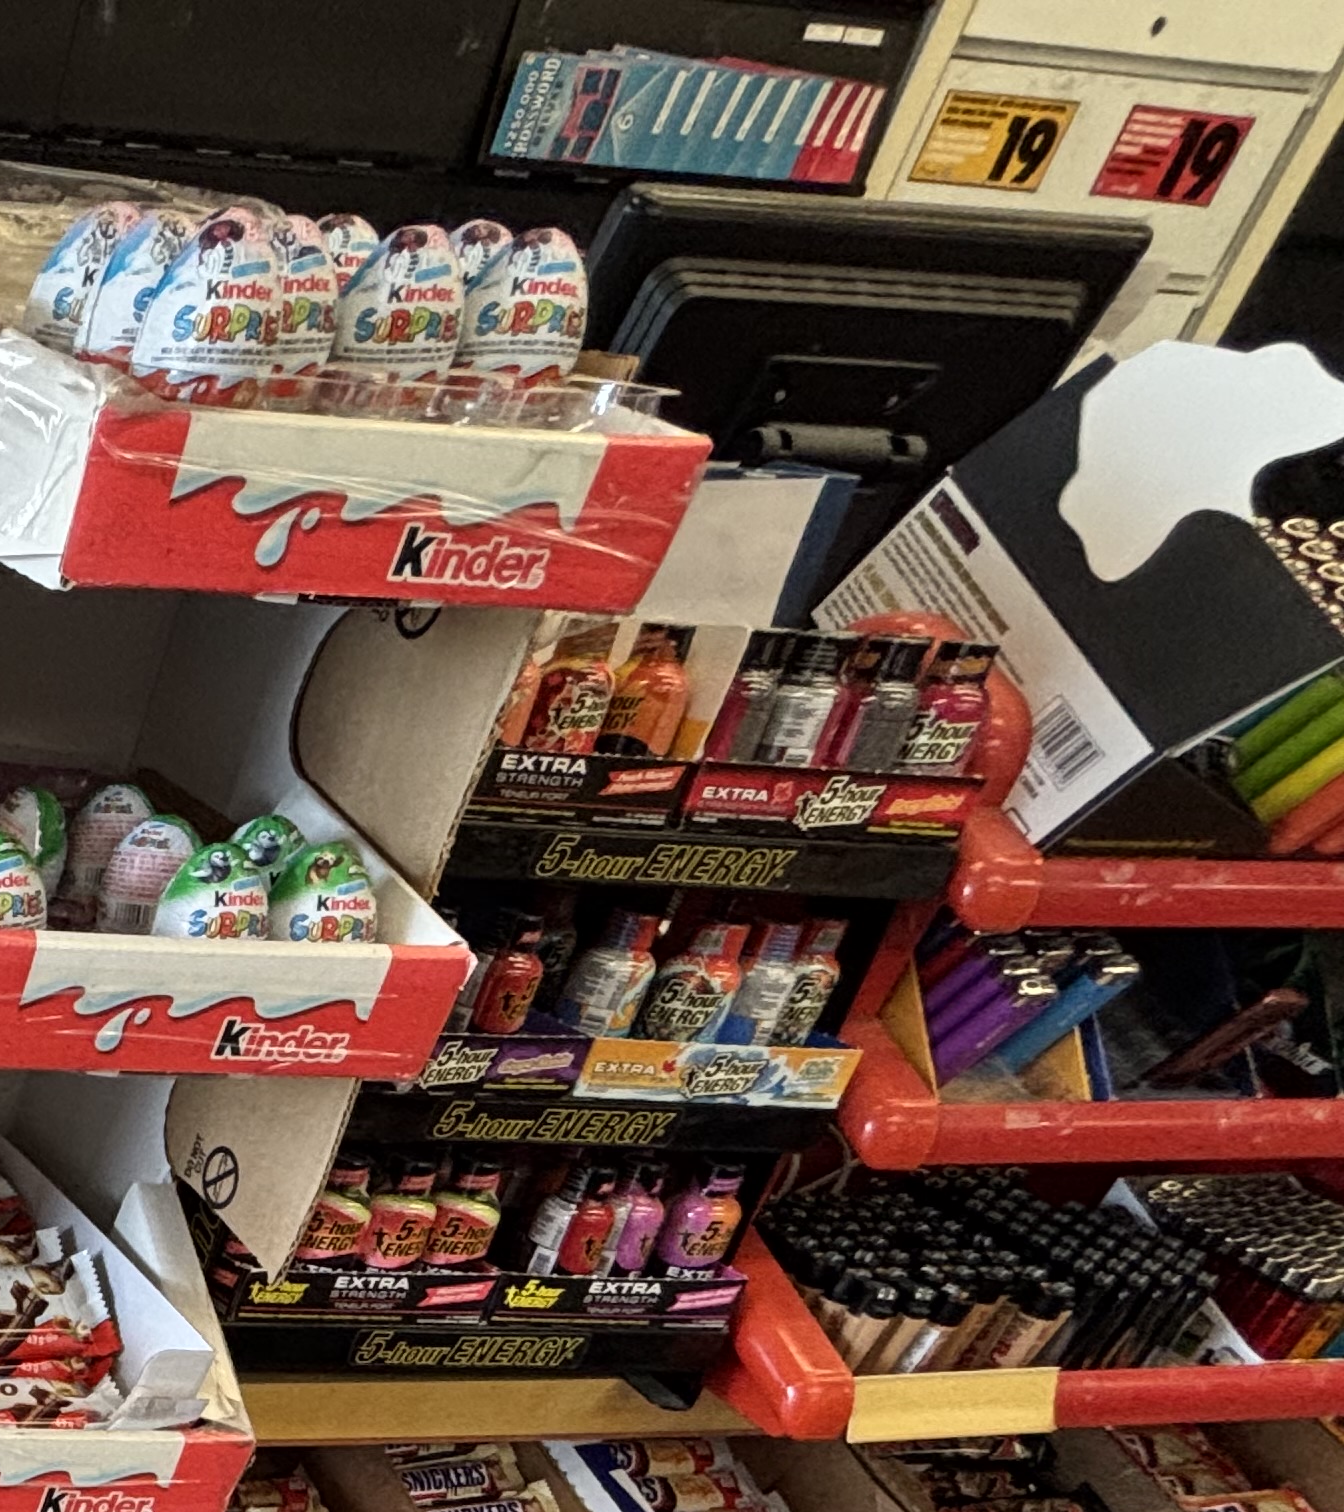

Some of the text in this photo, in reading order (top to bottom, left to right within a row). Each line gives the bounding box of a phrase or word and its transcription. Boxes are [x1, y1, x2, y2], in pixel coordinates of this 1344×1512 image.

[988, 115, 1060, 184] 19
[1156, 118, 1239, 200] 19
[206, 278, 272, 300] Kinder
[387, 282, 455, 303] Kinder
[510, 276, 578, 298] Kinder
[393, 525, 547, 588] Kinder
[501, 754, 587, 775] EXTRA
[495, 773, 584, 787] STRENGTH
[702, 786, 768, 802] EXTRA
[820, 779, 884, 805] 5-hour
[805, 802, 873, 824] ENERGY
[536, 835, 797, 886] 5-hour ENERGY
[662, 979, 723, 1008] 5-hour
[648, 1007, 713, 1025] ENERGY
[214, 1017, 349, 1062] Kinder
[440, 1041, 499, 1067] 5-hour
[426, 1063, 486, 1086] ENERGY
[594, 1062, 655, 1075] EXTRA
[705, 1054, 765, 1077] 5-hour
[693, 1075, 754, 1093] ENERGY
[434, 1102, 678, 1144] 5-hour ENERGY
[329, 1289, 407, 1299] STRENGTH
[334, 1276, 409, 1290] EXTRA
[588, 1282, 662, 1295] EXTRA
[583, 1295, 659, 1304] STRENGTH
[352, 1331, 586, 1368] 5-hour ENERGY
[402, 1464, 487, 1494] SNICKERS
